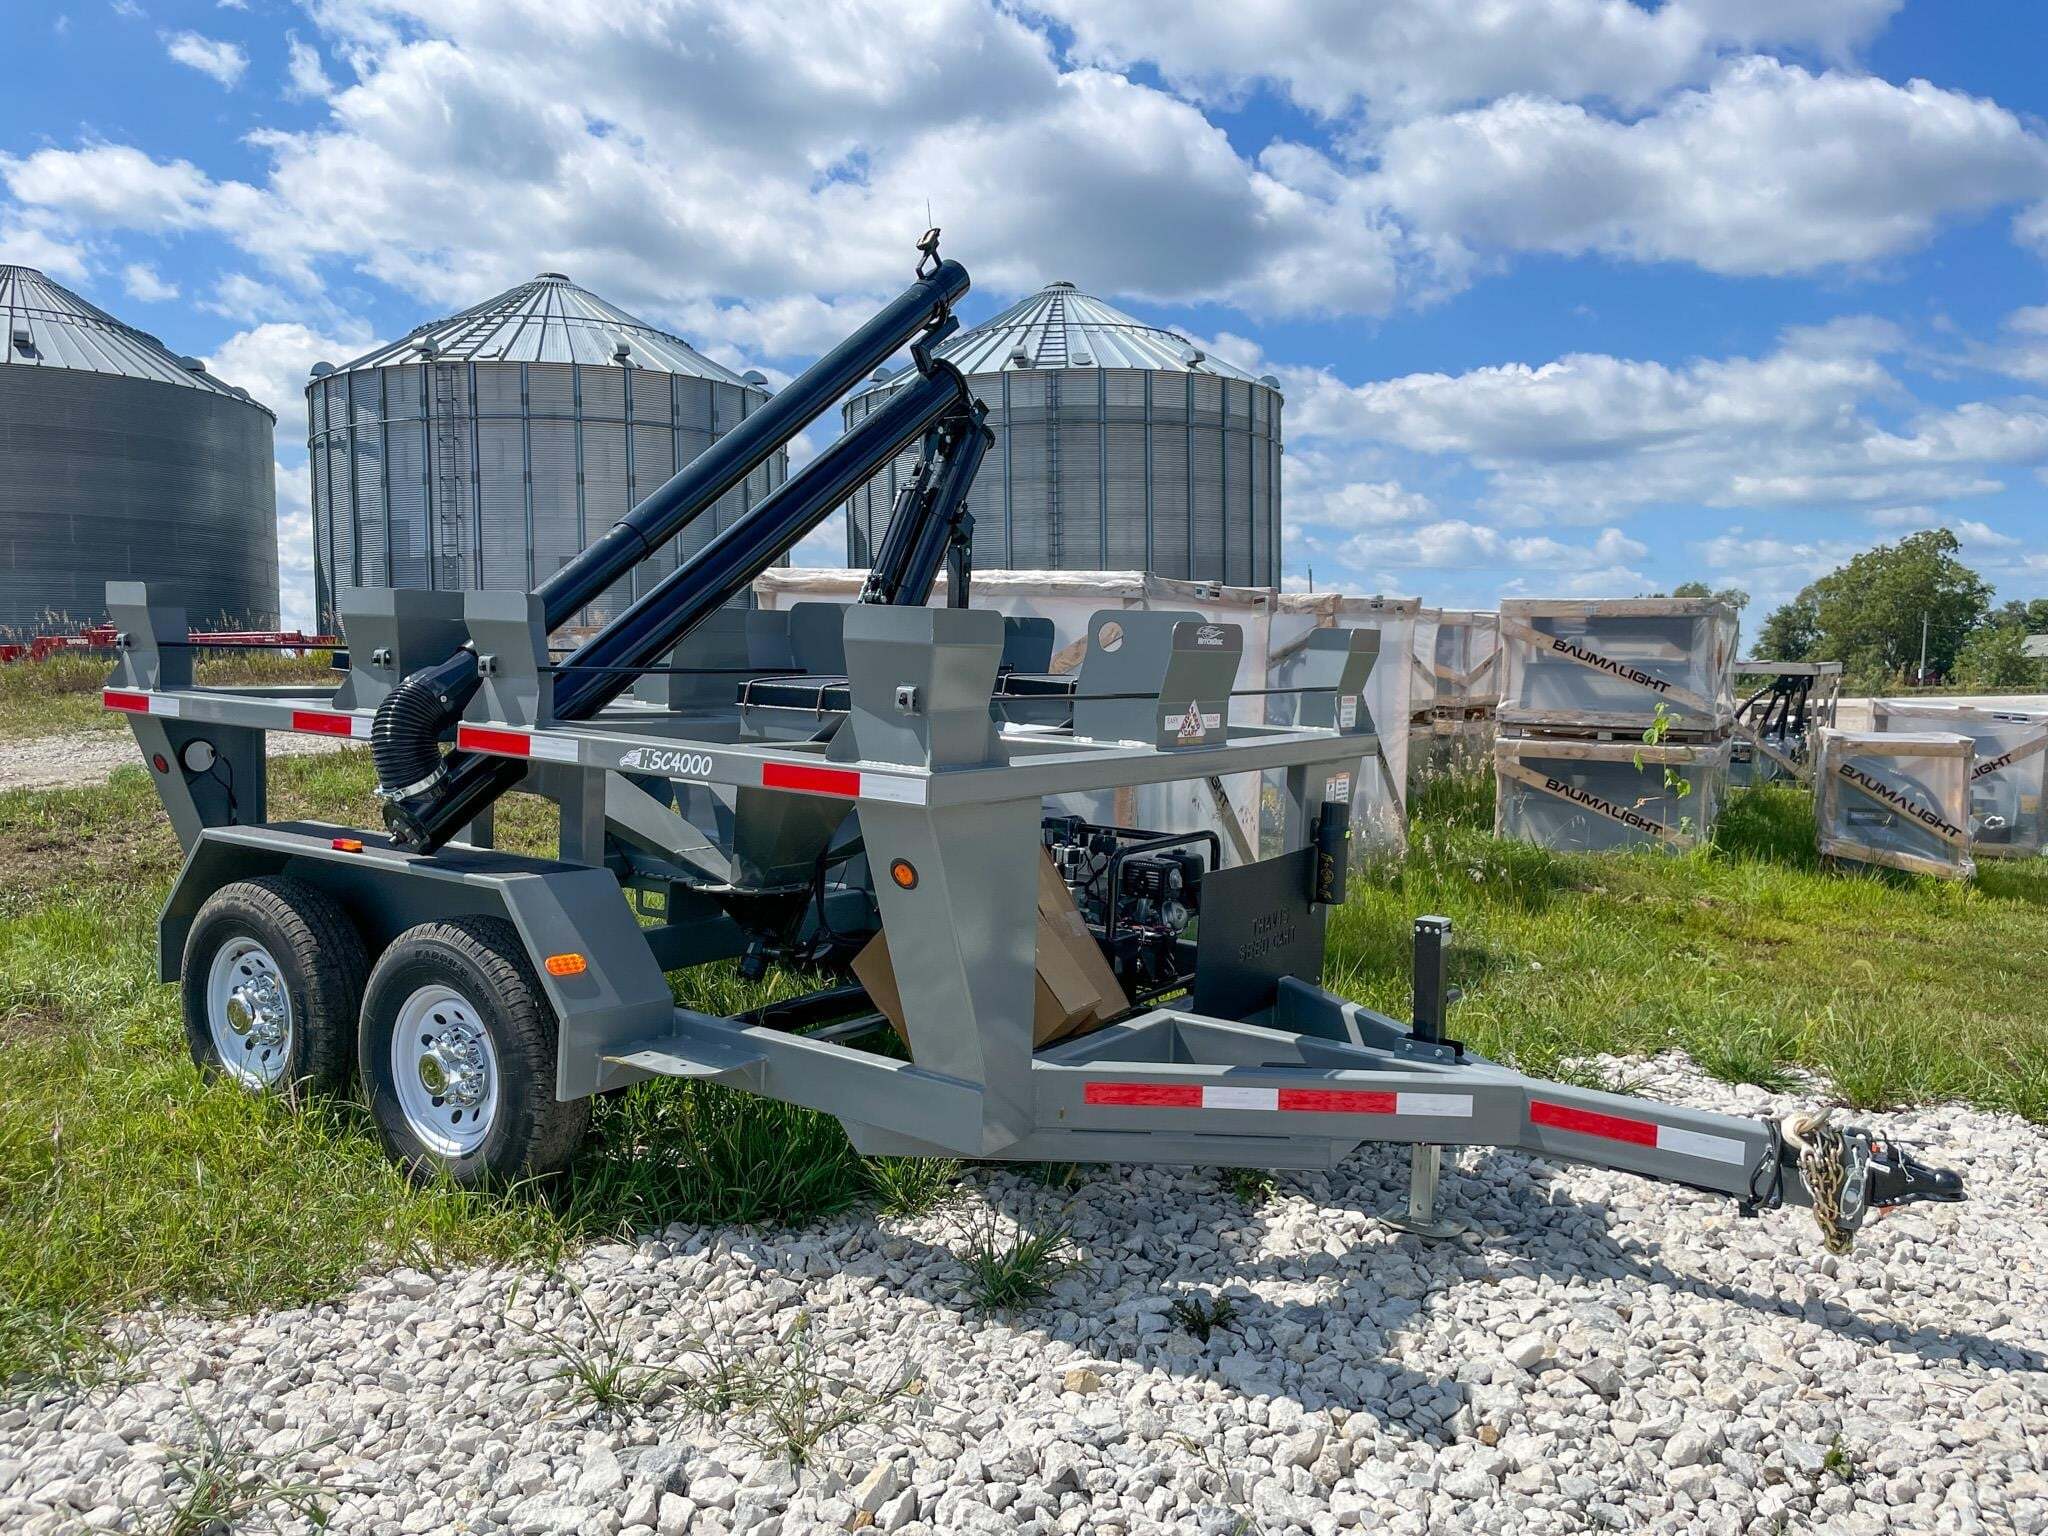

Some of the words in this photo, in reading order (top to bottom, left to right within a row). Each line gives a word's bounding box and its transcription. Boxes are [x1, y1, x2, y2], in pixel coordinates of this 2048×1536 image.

[1552, 639, 1672, 693] BAUMALIGHT
[1545, 778, 1664, 836] BAUMALIGHT
[1838, 763, 1963, 838] BAUMALIGHT
